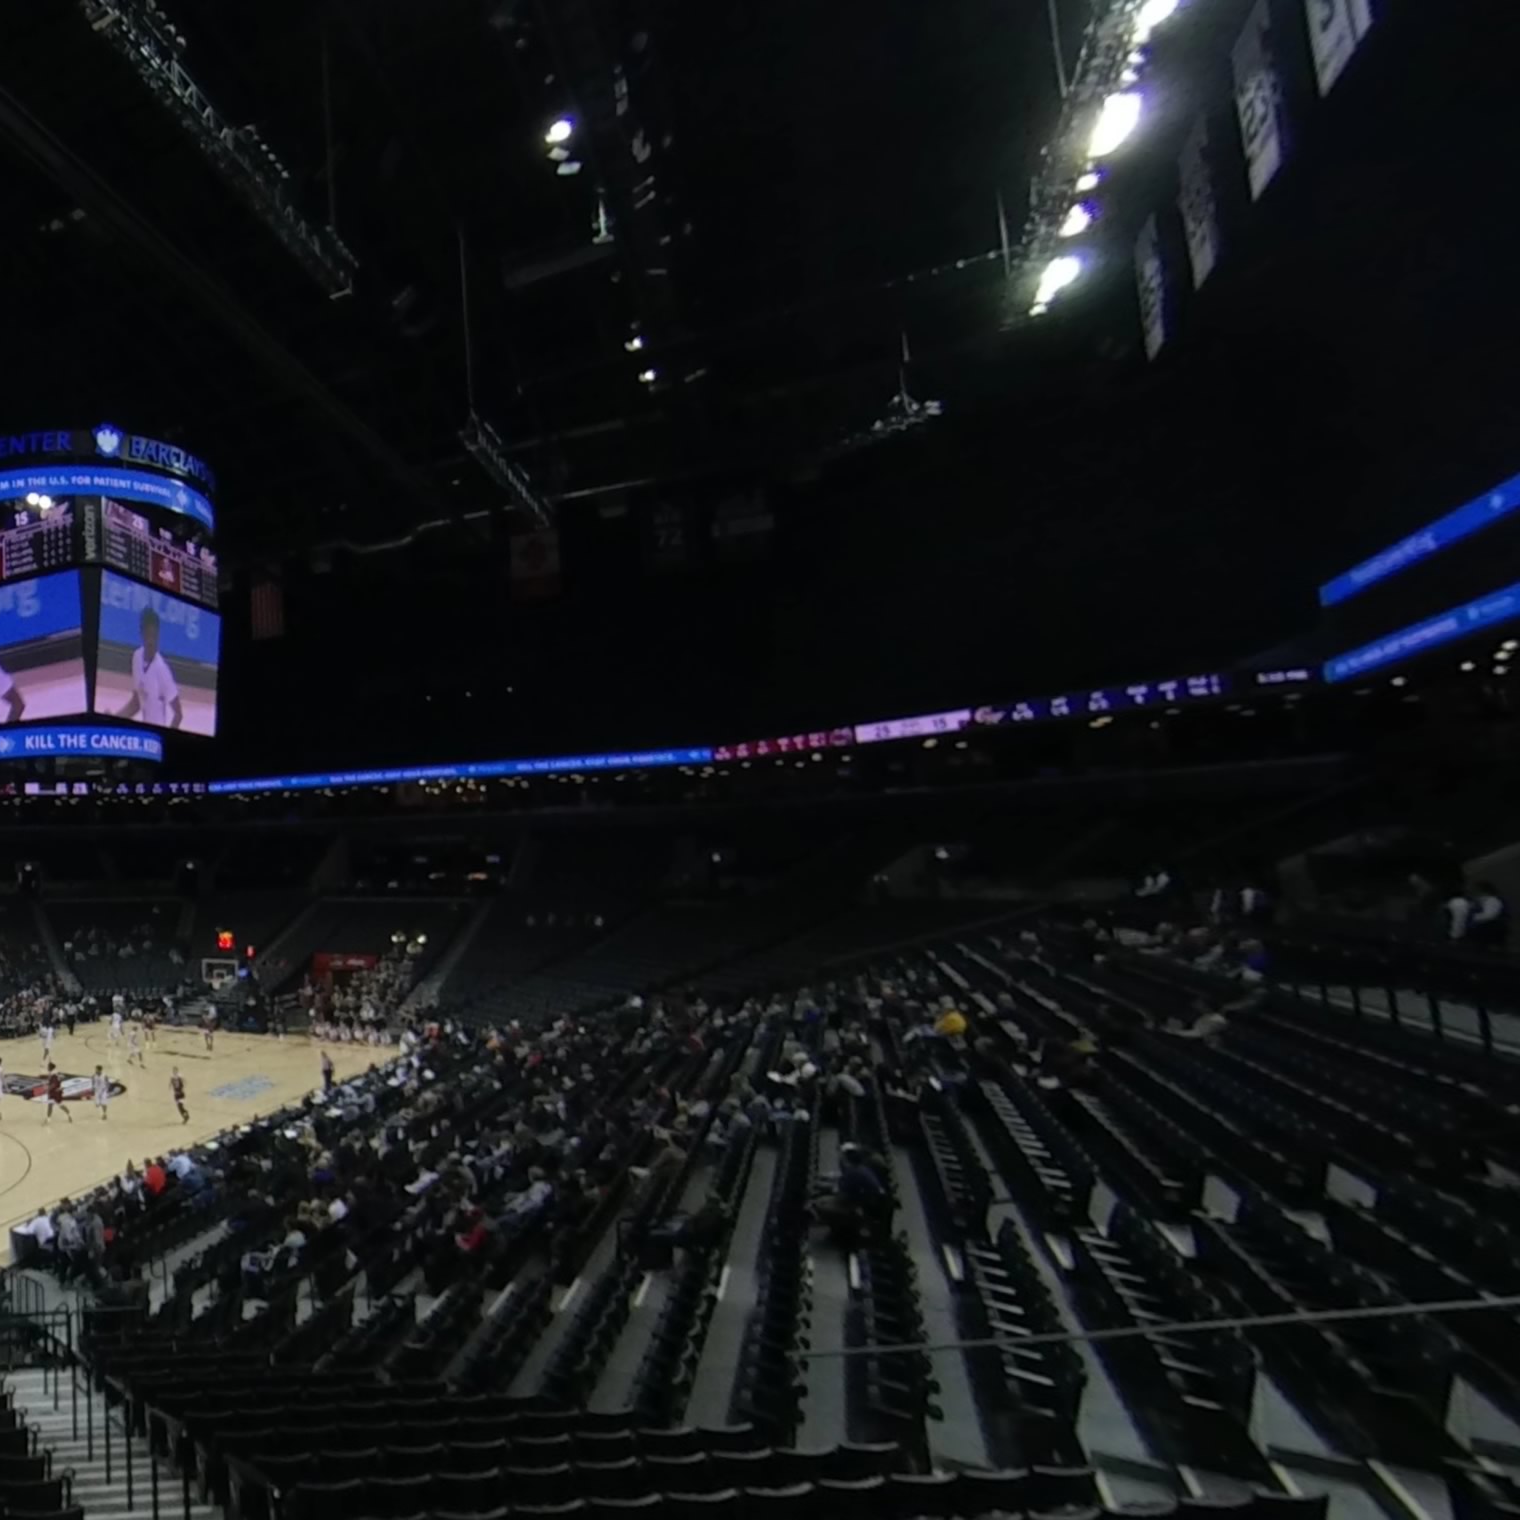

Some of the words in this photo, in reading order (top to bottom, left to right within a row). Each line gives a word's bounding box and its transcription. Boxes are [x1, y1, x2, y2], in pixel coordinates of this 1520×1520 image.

[12, 477, 25, 488] IN
[28, 476, 46, 486] THE
[49, 475, 69, 485] U.S.
[71, 476, 91, 486] FOR
[94, 476, 131, 489] PATIENT
[15, 511, 29, 526] 15
[82, 505, 96, 560] verizon
[25, 734, 56, 749] KILL
[57, 734, 87, 748] THE
[90, 734, 144, 751] CANCER.
